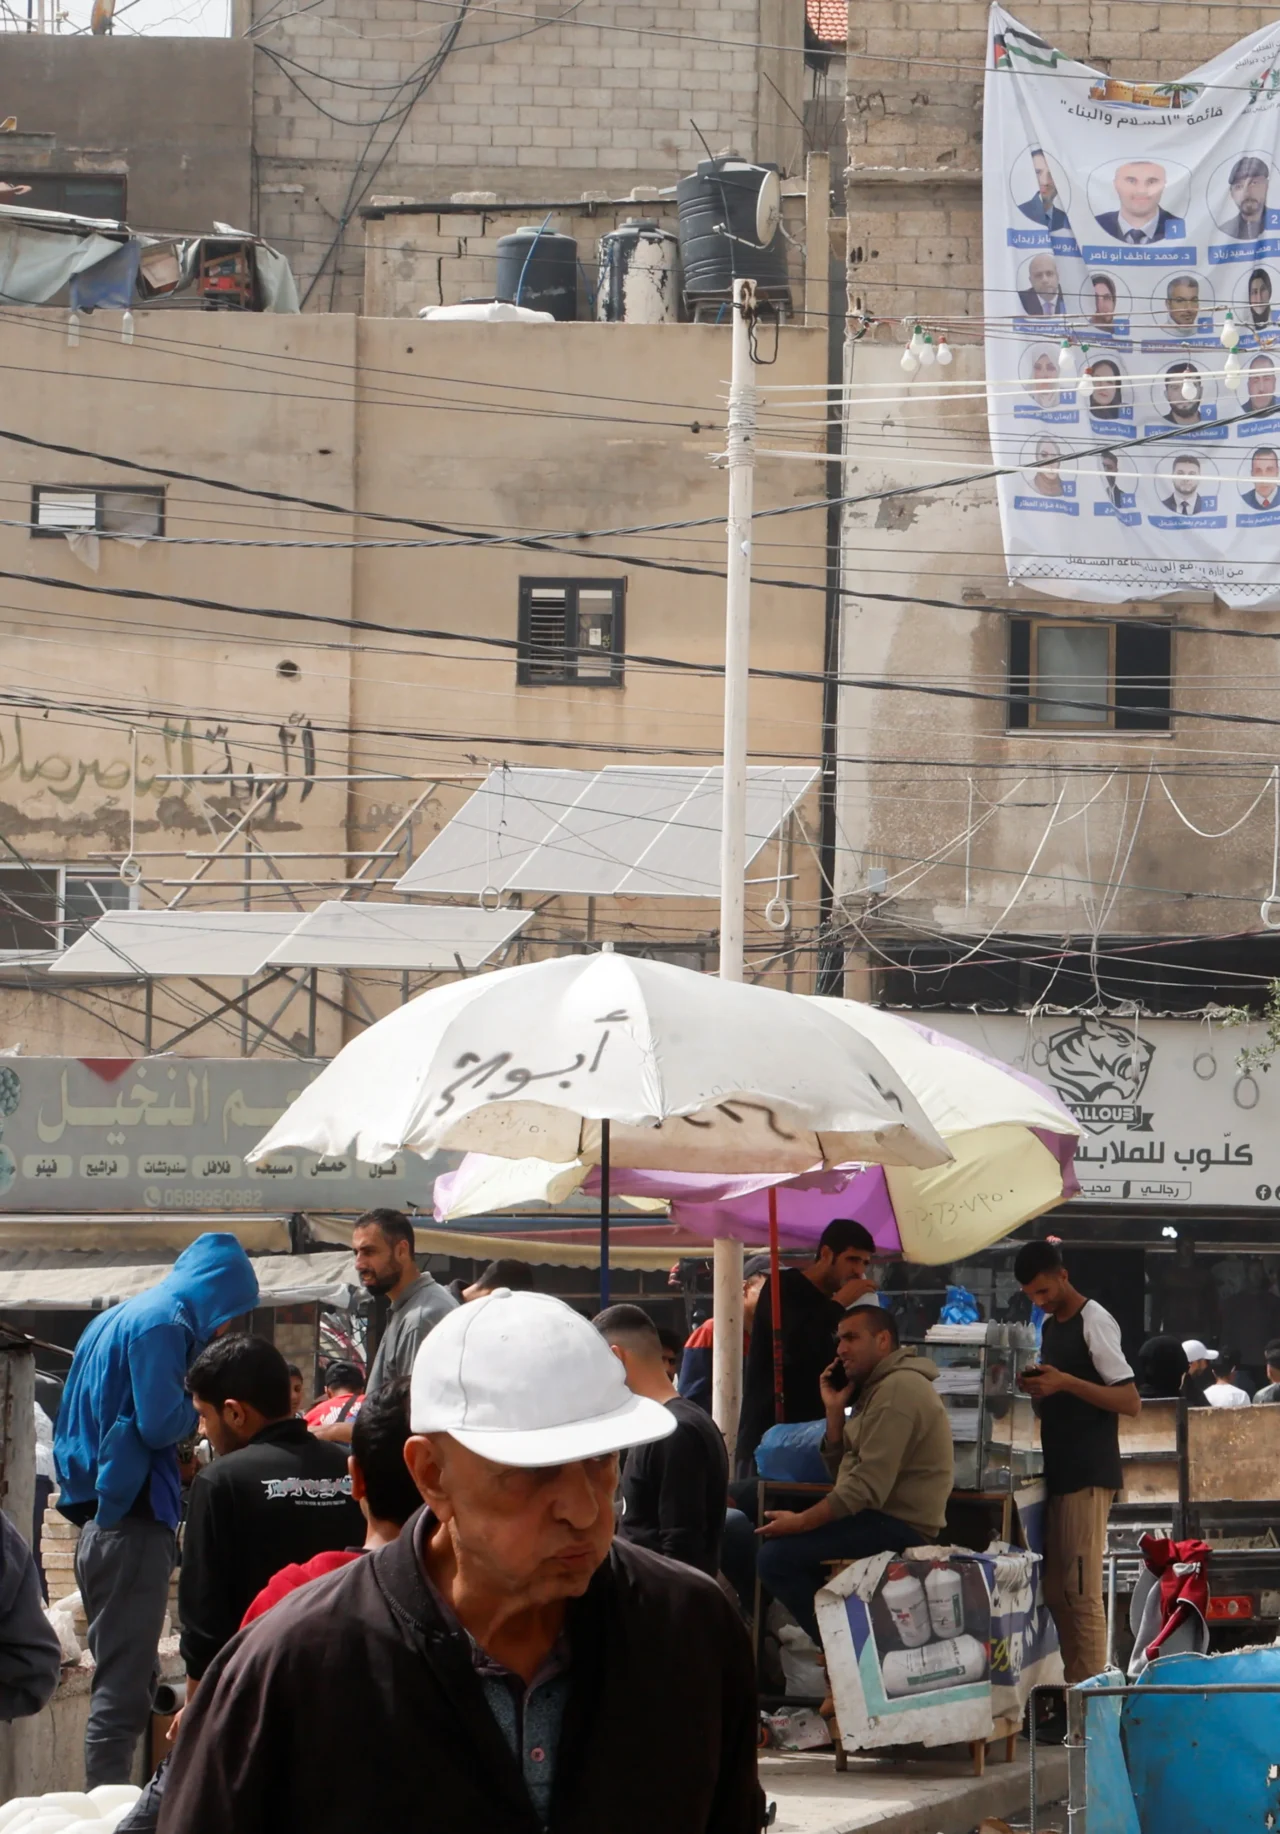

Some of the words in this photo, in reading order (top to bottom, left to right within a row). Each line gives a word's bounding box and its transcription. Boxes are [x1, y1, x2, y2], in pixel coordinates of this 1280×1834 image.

[1186, 106, 1224, 126] قائمة
[1271, 214, 1279, 224] 2
[1171, 224, 1178, 234] 1
[1089, 249, 1109, 261] ناصر
[1110, 247, 1122, 262] أبو
[1124, 251, 1152, 261] عاطف
[1154, 253, 1179, 261] محمد
[1062, 391, 1073, 400] 11
[1205, 407, 1212, 416] 9
[1062, 485, 1073, 493] 15
[1203, 499, 1215, 508] 13
[1226, 567, 1244, 579] من
[37, 1064, 210, 1146] النخيل
[34, 1158, 58, 1177] فينو
[201, 1159, 232, 1176] فلافل
[309, 1158, 348, 1177] حمص
[368, 1160, 398, 1179] فول
[1140, 1184, 1180, 1198] رجالي
